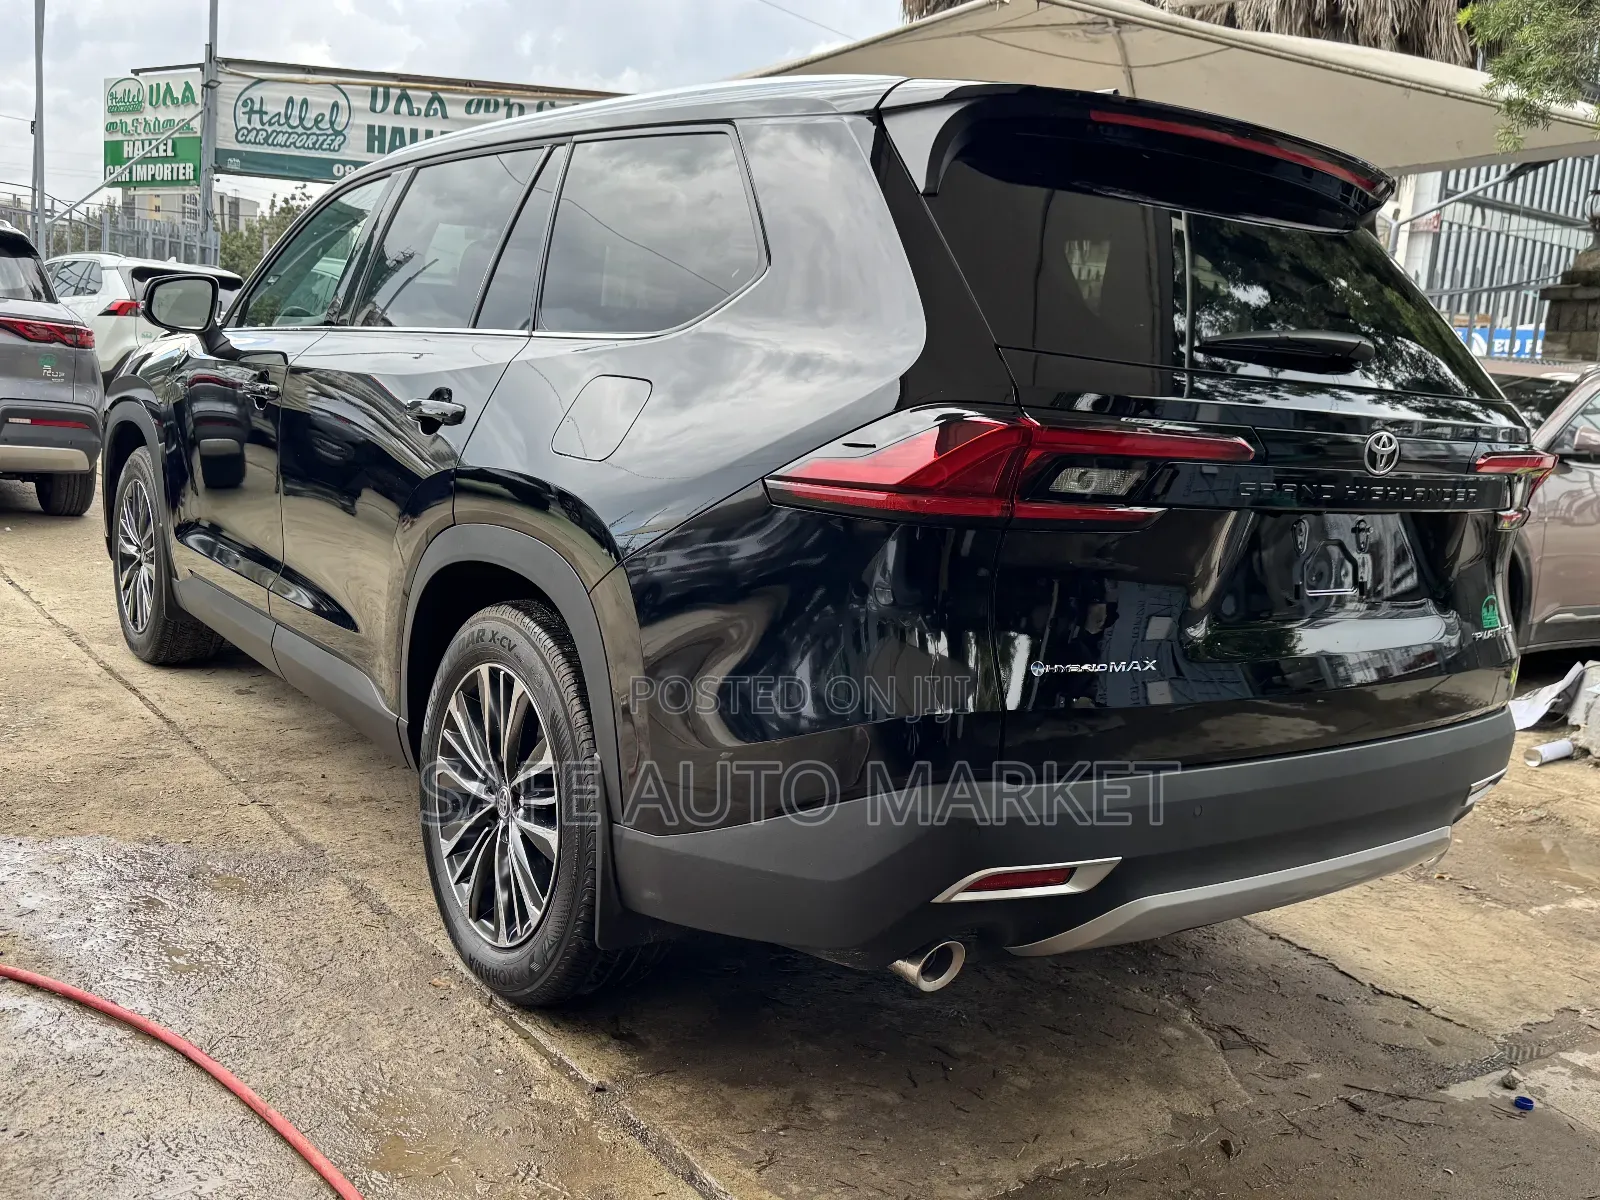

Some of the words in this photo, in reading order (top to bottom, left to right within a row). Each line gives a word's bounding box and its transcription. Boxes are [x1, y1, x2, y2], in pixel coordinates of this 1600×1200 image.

[109, 88, 144, 104] Hallel
[241, 96, 348, 134] Hallel
[123, 138, 175, 158] HALLEL
[237, 128, 268, 144] CAR
[268, 131, 345, 150] IMPORTER
[366, 124, 457, 154] HAL
[106, 165, 129, 182] CAR
[132, 163, 194, 181] IMPORTER
[1240, 482, 1335, 499] GRAND
[1346, 485, 1478, 502] HIGHLANDER
